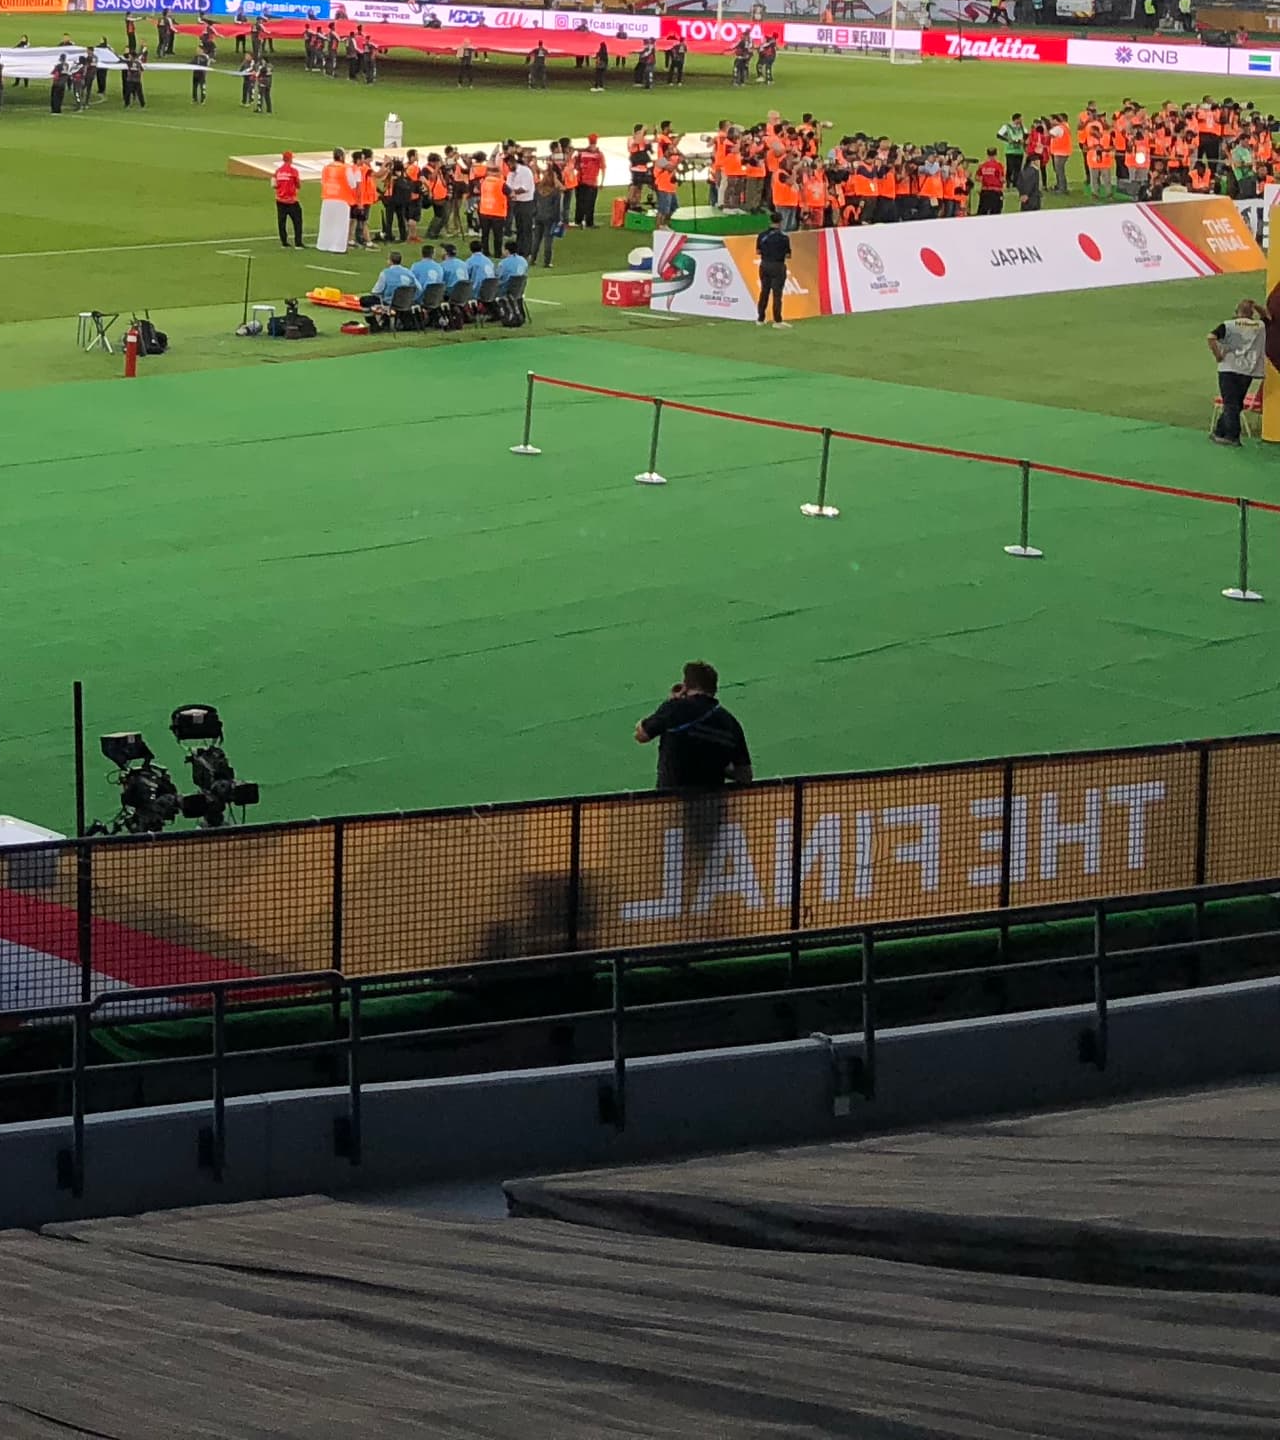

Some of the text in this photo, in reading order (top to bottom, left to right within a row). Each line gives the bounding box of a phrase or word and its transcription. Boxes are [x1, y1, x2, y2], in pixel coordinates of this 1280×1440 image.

[573, 17, 649, 33] @fcasiancup
[1138, 49, 1178, 64] QNB
[1202, 217, 1234, 235] THE
[1206, 235, 1251, 254] FINAL
[990, 246, 1043, 267] JAPAN
